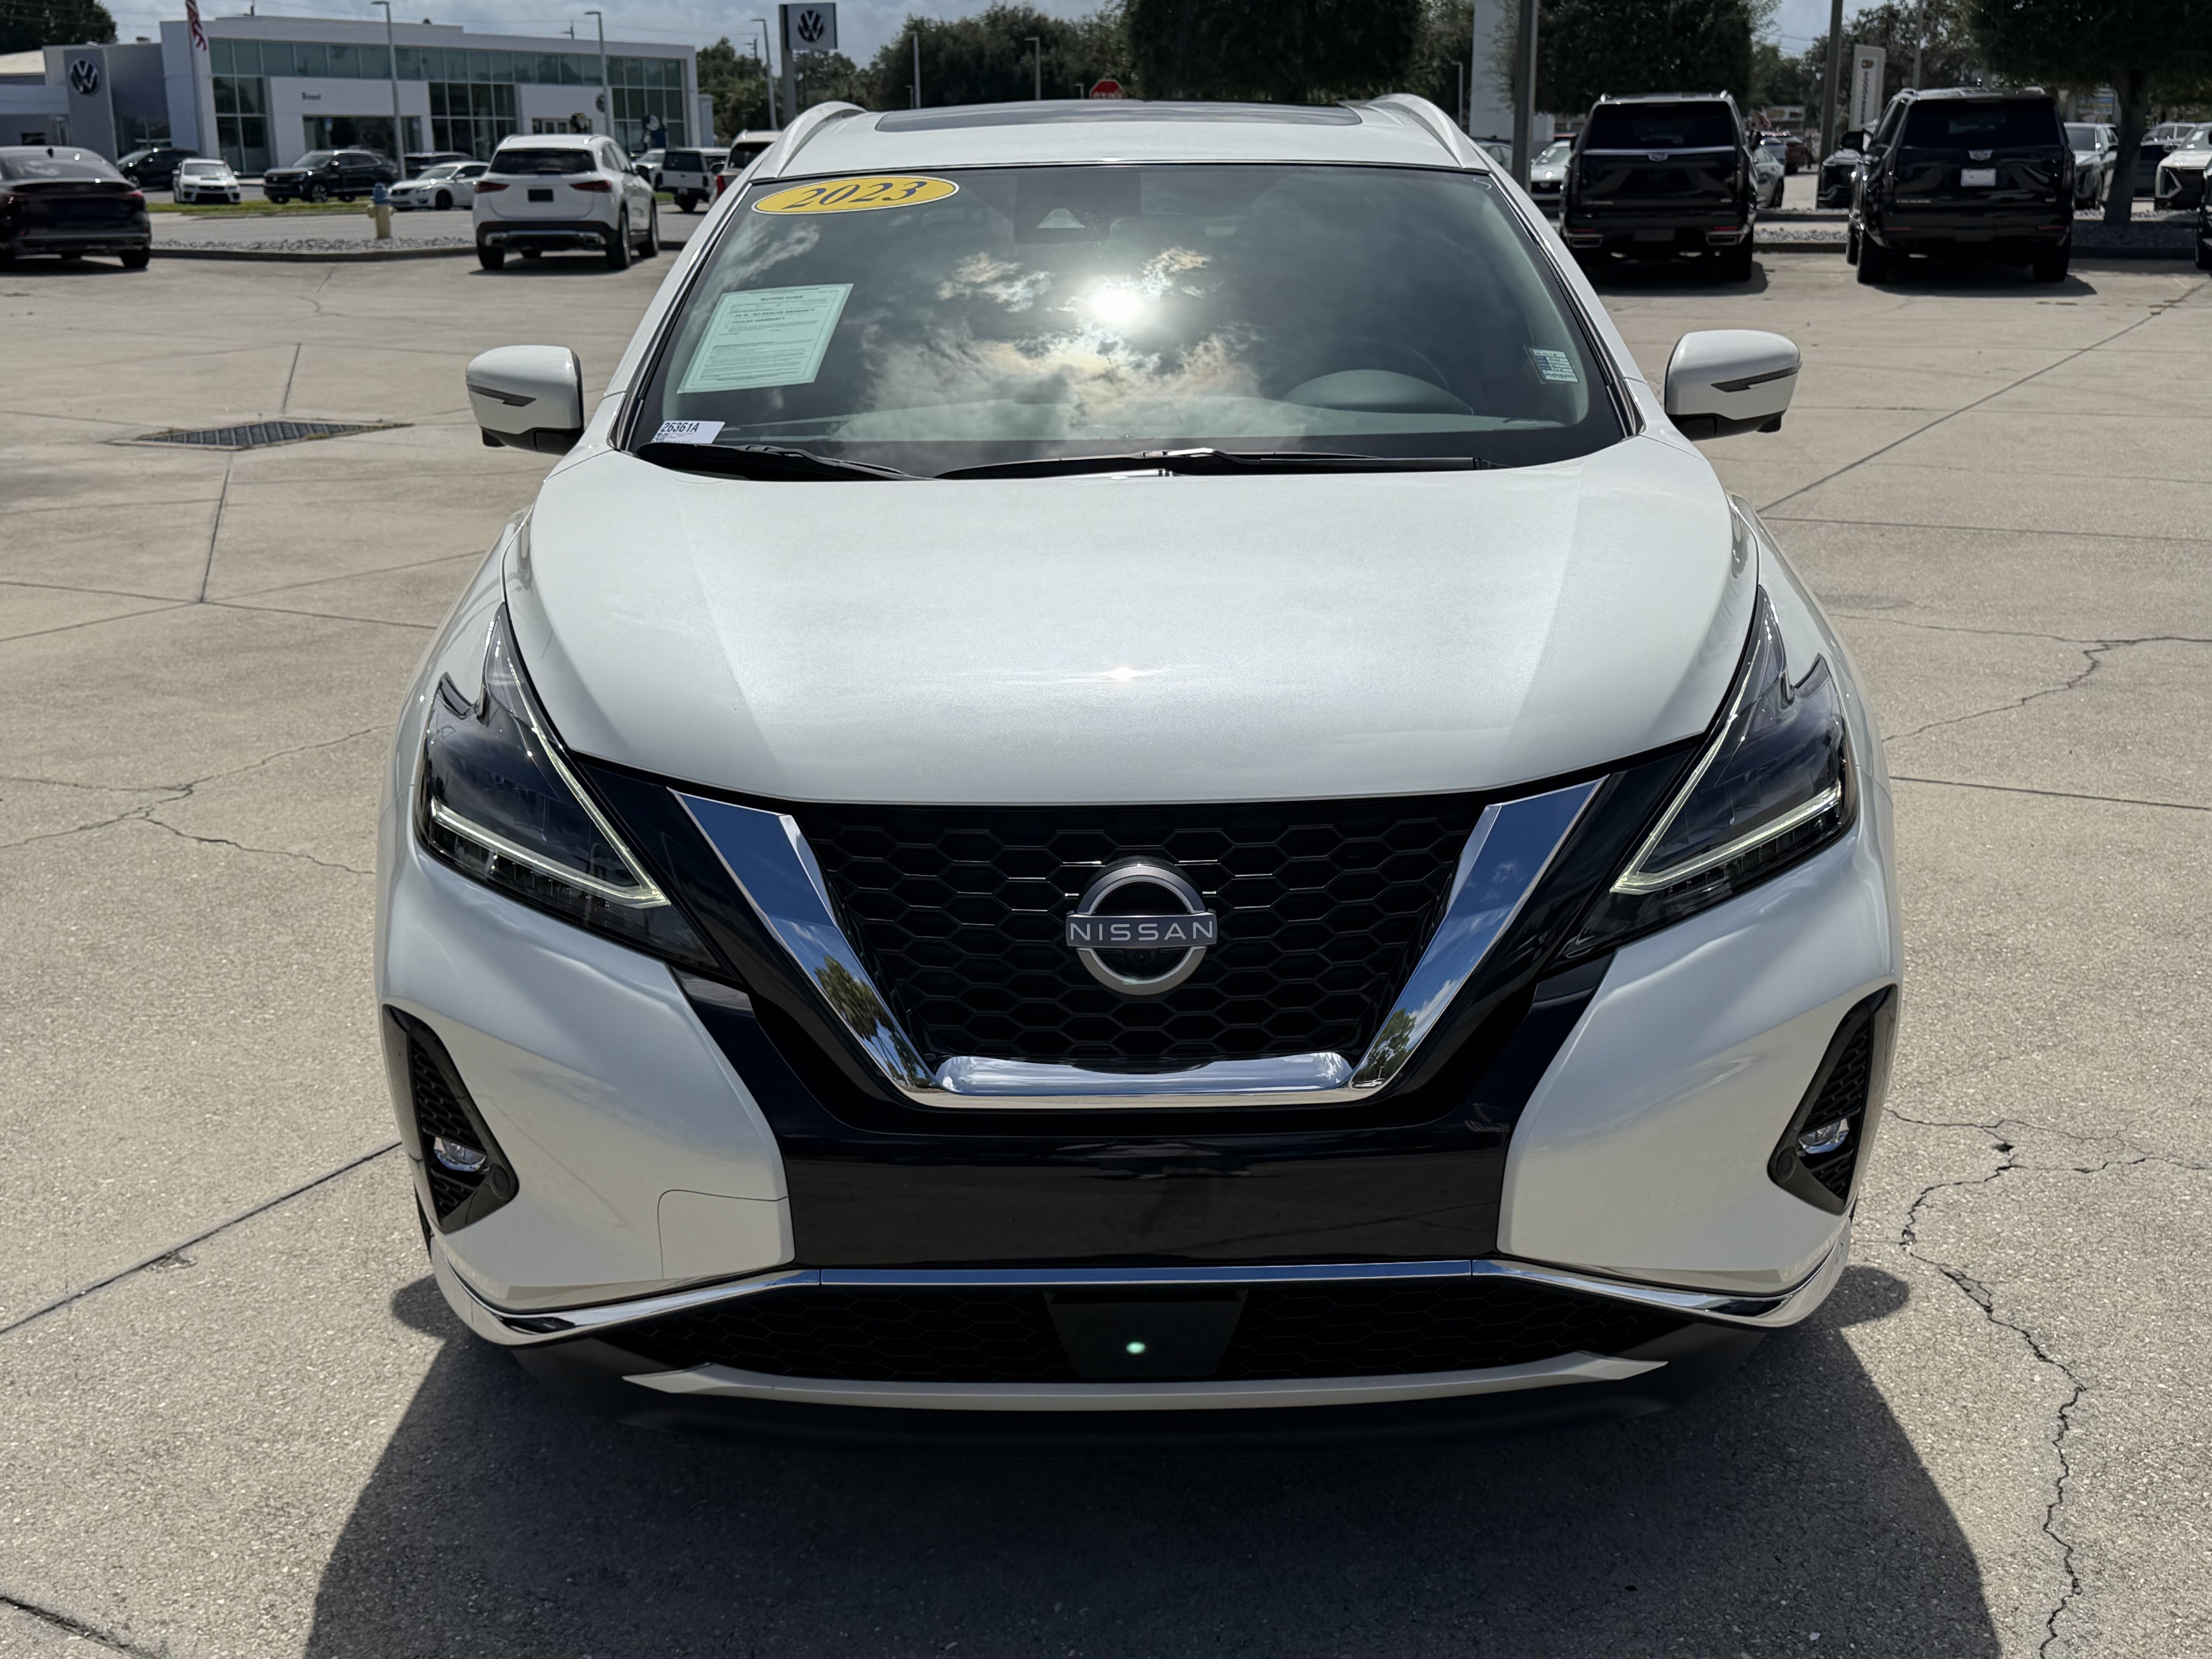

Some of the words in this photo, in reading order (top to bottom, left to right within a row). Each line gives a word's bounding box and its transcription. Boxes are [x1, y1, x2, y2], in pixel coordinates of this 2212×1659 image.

[781, 181, 927, 210] 2023
[660, 422, 700, 433] 26361A
[1070, 921, 1213, 941] NISSAN
